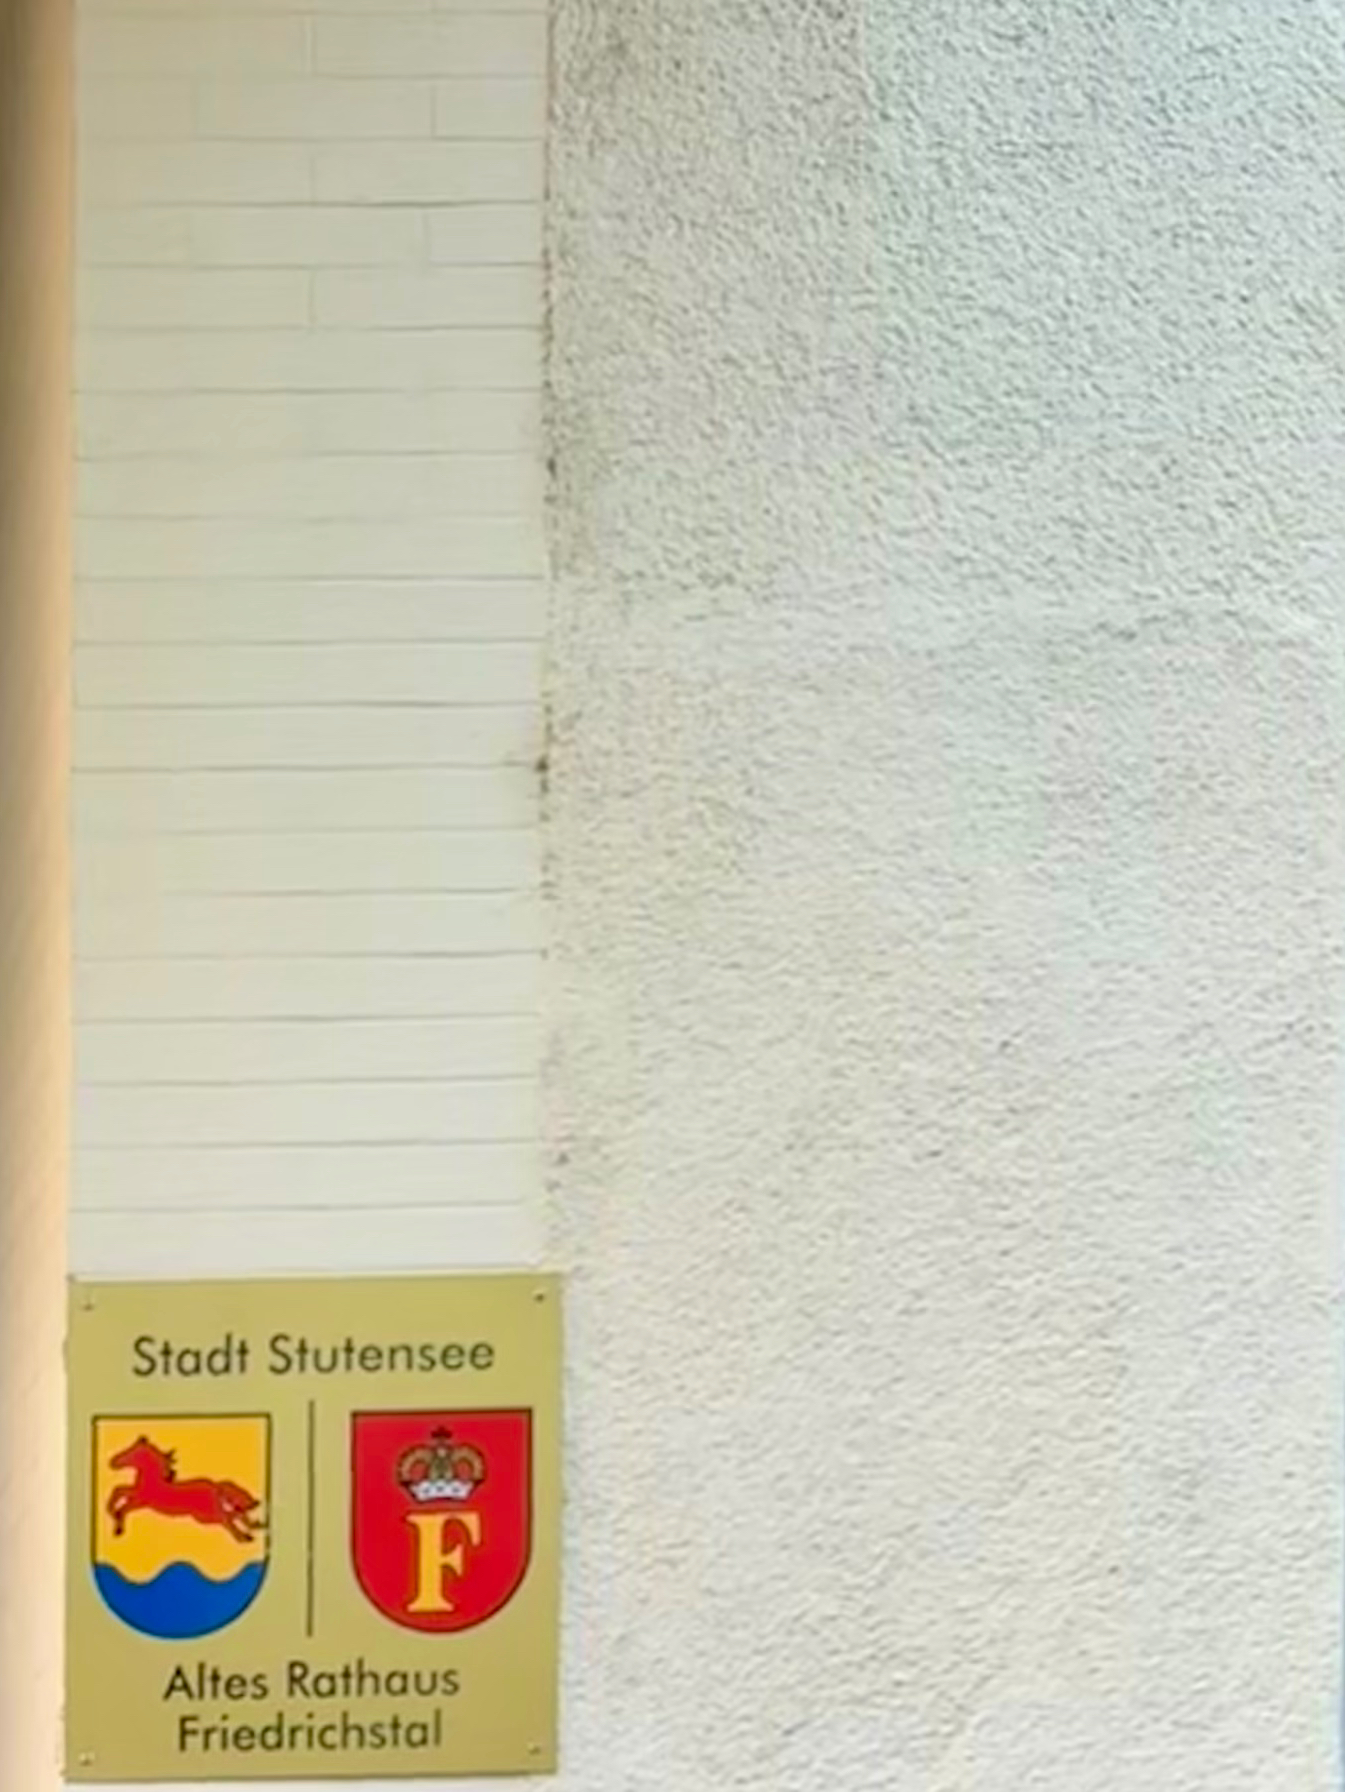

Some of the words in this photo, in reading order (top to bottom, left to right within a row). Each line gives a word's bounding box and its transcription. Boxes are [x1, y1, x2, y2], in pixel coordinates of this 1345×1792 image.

[132, 1332, 249, 1377] Stadt
[268, 1333, 494, 1373] Stutensee
[407, 1511, 481, 1612] F
[163, 1663, 269, 1701] Altes
[287, 1659, 459, 1699] Rathaus
[179, 1710, 442, 1752] Friedrichstal
